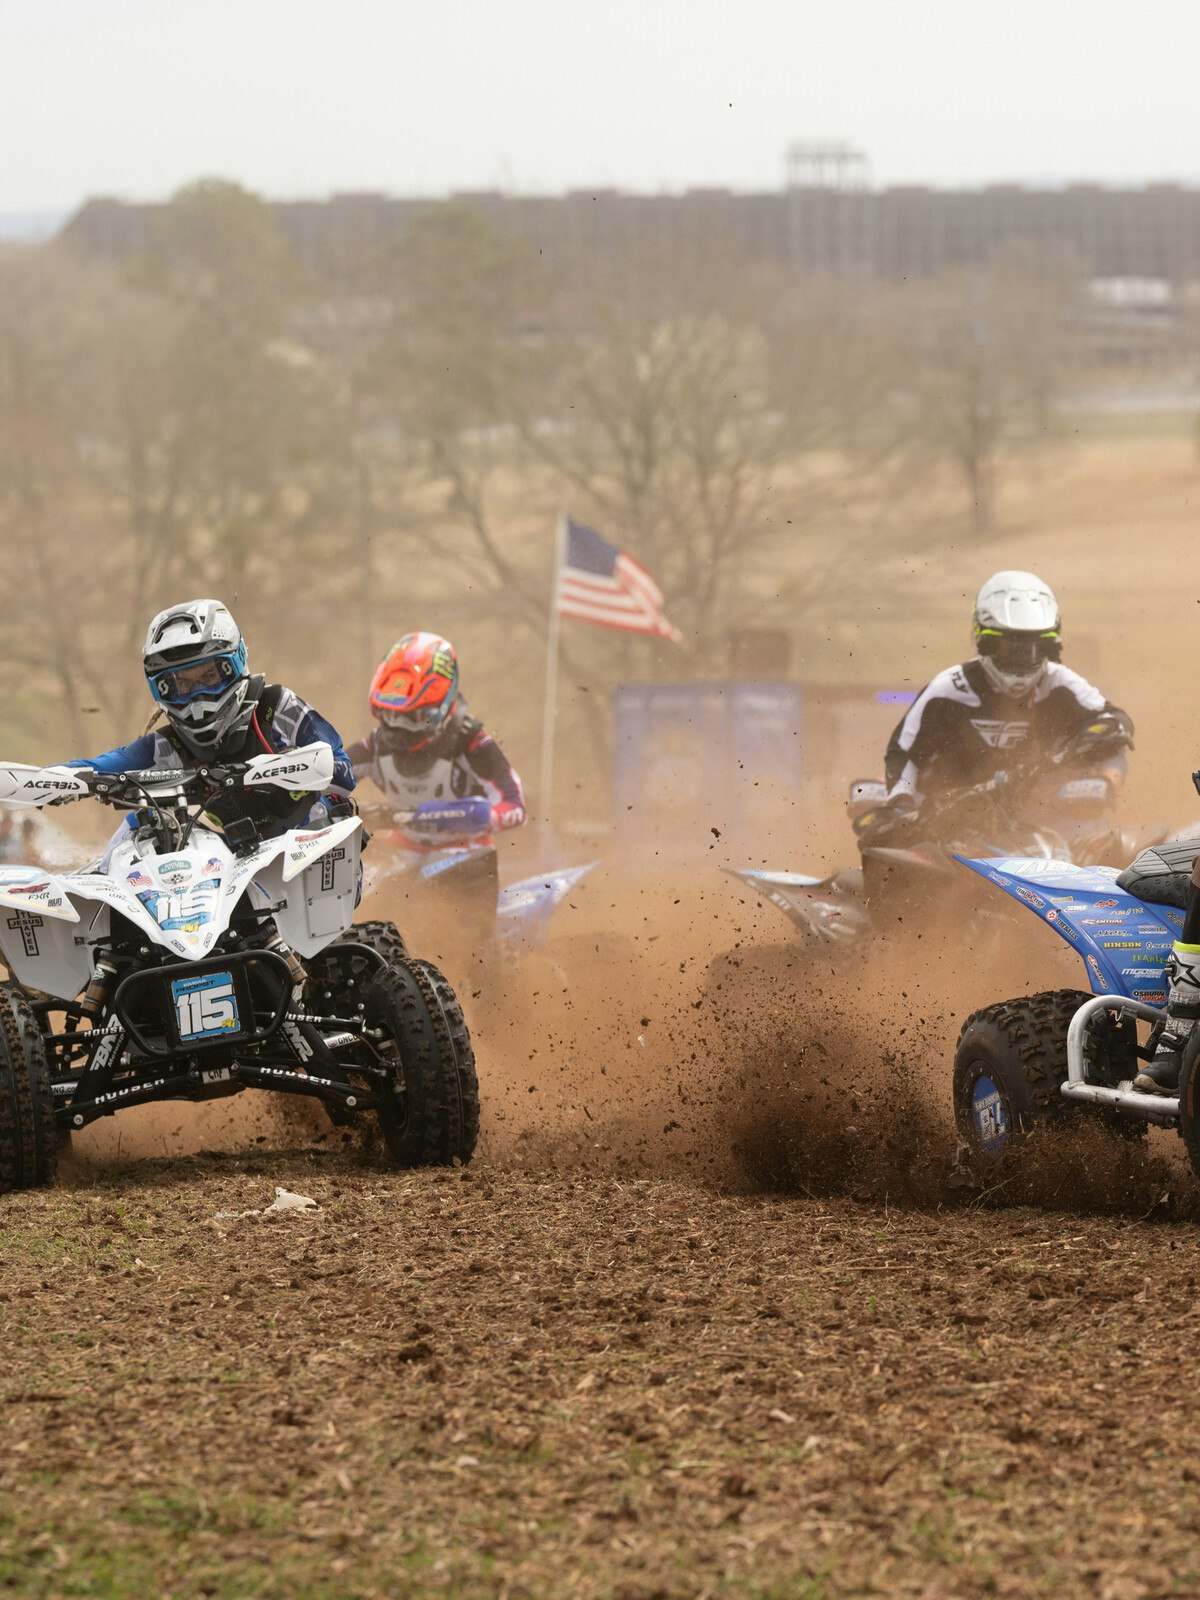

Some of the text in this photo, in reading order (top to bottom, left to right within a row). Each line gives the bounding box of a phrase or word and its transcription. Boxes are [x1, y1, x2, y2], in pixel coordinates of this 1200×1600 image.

[251, 763, 310, 781] ACERBIS
[23, 780, 81, 790] ACERBIS
[320, 851, 343, 861] ESUS
[154, 884, 219, 924] 115
[11, 917, 41, 927] JESUS
[1132, 954, 1168, 965] FEARLES
[175, 980, 216, 993] PROPST
[1132, 988, 1165, 997] OSBURN
[176, 983, 235, 1037] 115
[271, 1010, 323, 1023] HUSER
[84, 1025, 126, 1038] HOUSE
